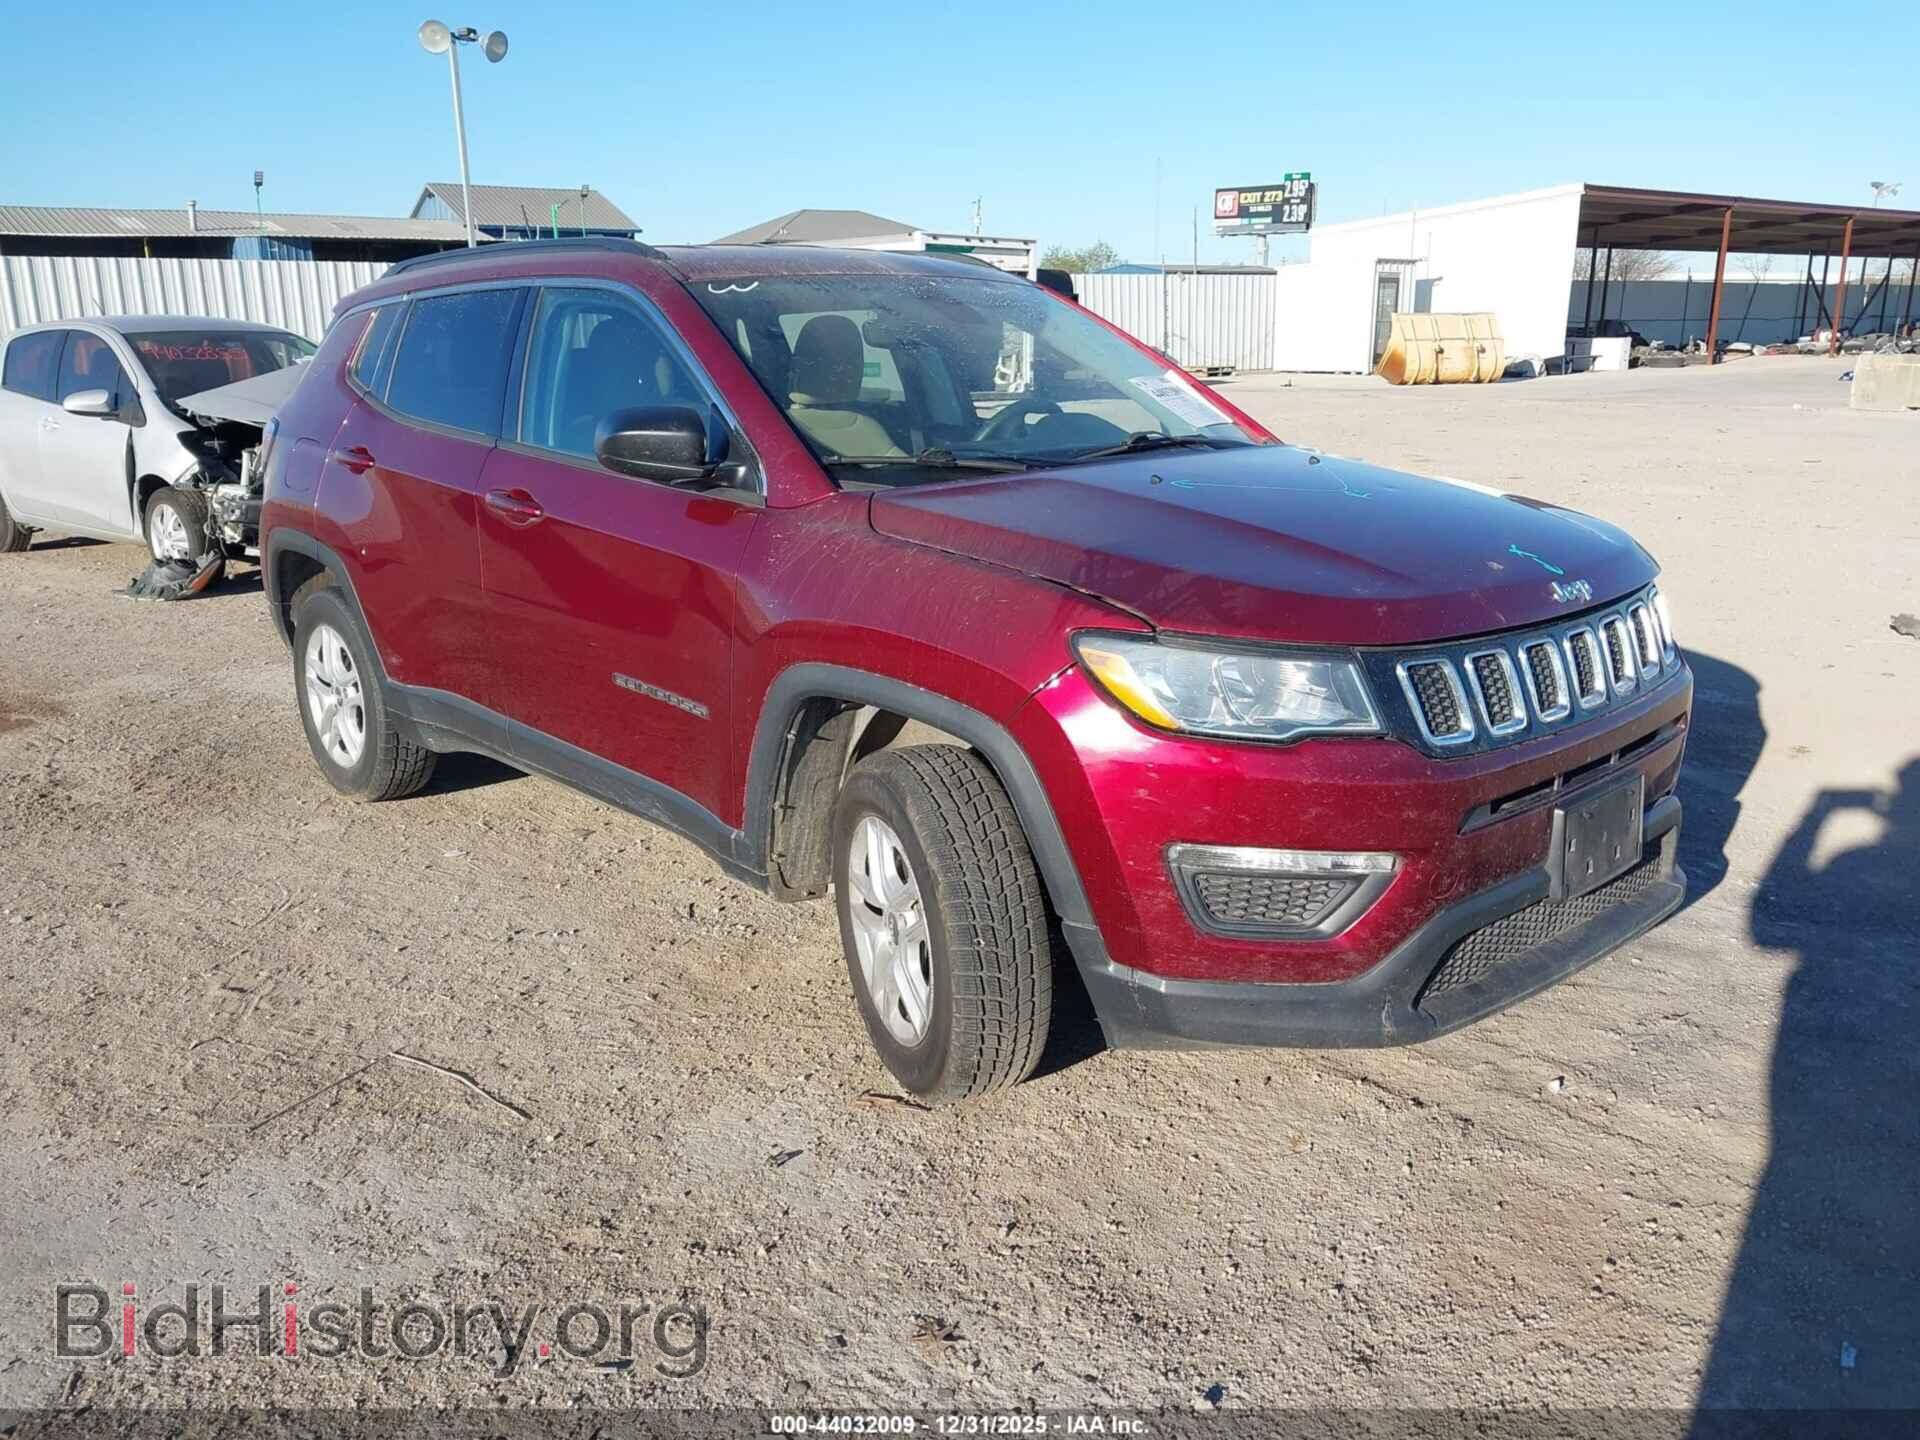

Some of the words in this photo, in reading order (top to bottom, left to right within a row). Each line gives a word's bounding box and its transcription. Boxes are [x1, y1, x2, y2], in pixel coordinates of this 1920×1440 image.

[1240, 192, 1263, 203] EXIT
[1264, 190, 1284, 202] 273
[1551, 580, 1593, 604] Jeep
